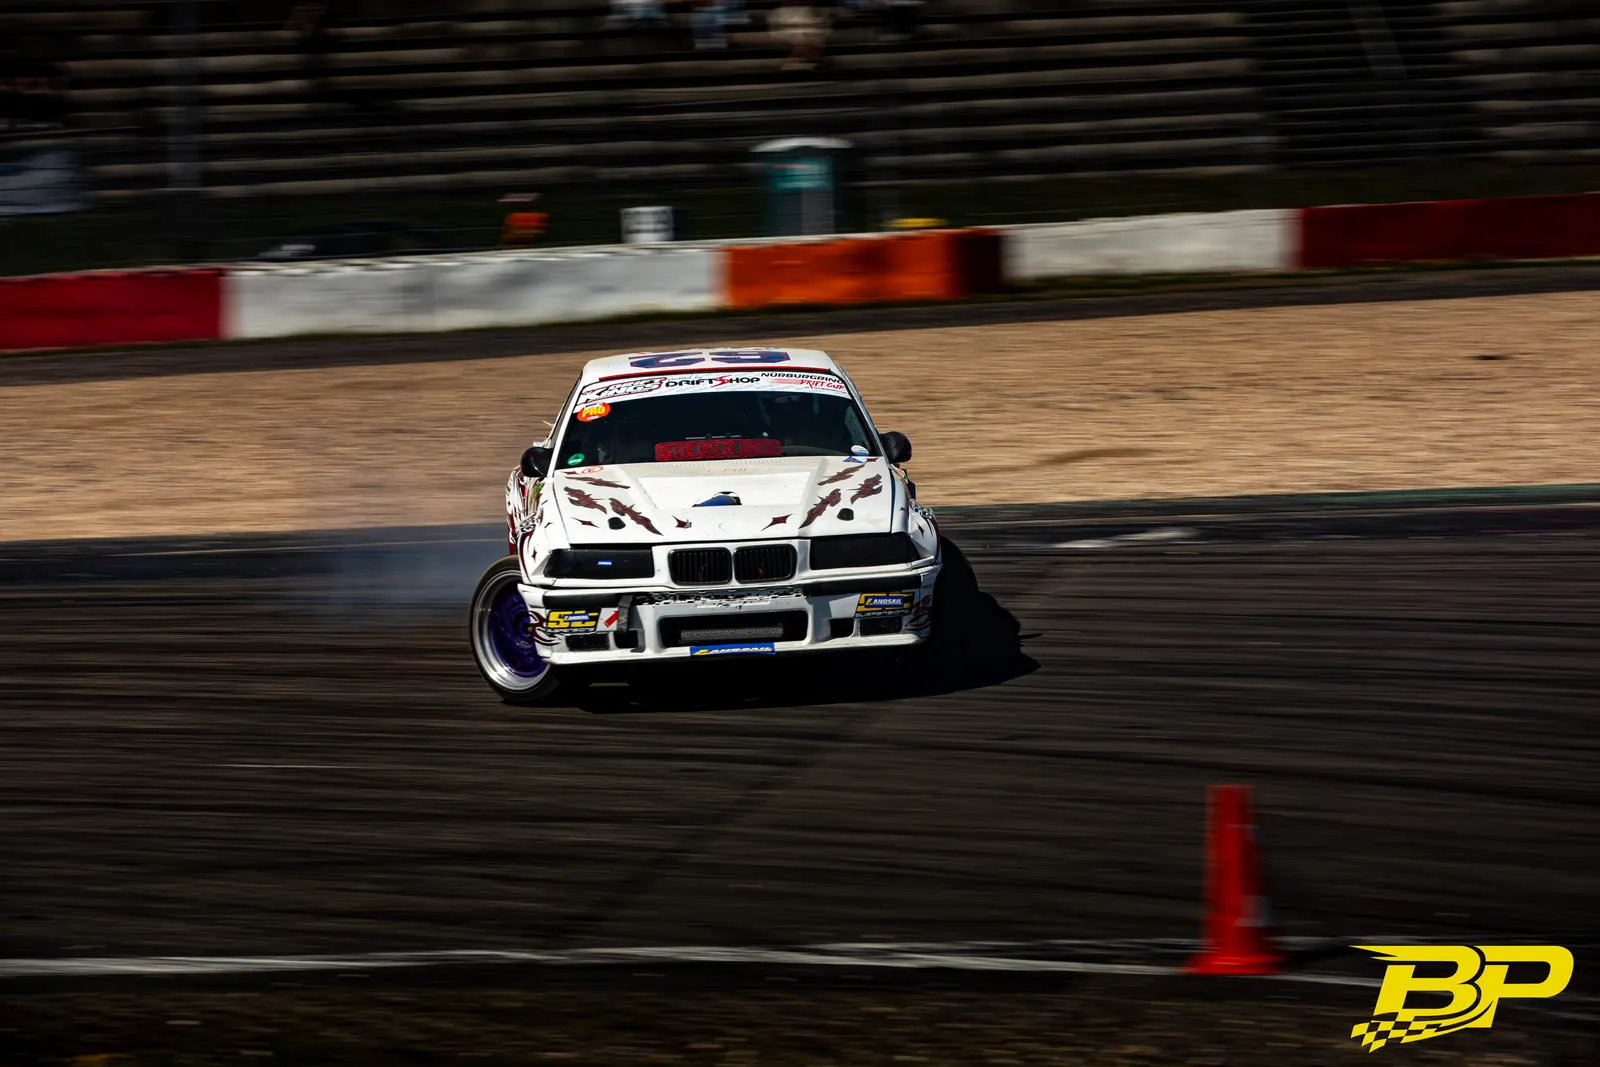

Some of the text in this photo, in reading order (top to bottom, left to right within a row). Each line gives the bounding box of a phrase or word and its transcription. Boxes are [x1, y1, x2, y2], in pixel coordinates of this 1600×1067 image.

[582, 405, 606, 417] PRO
[659, 440, 735, 459] STICKER
[865, 598, 903, 606] LANDSAIL
